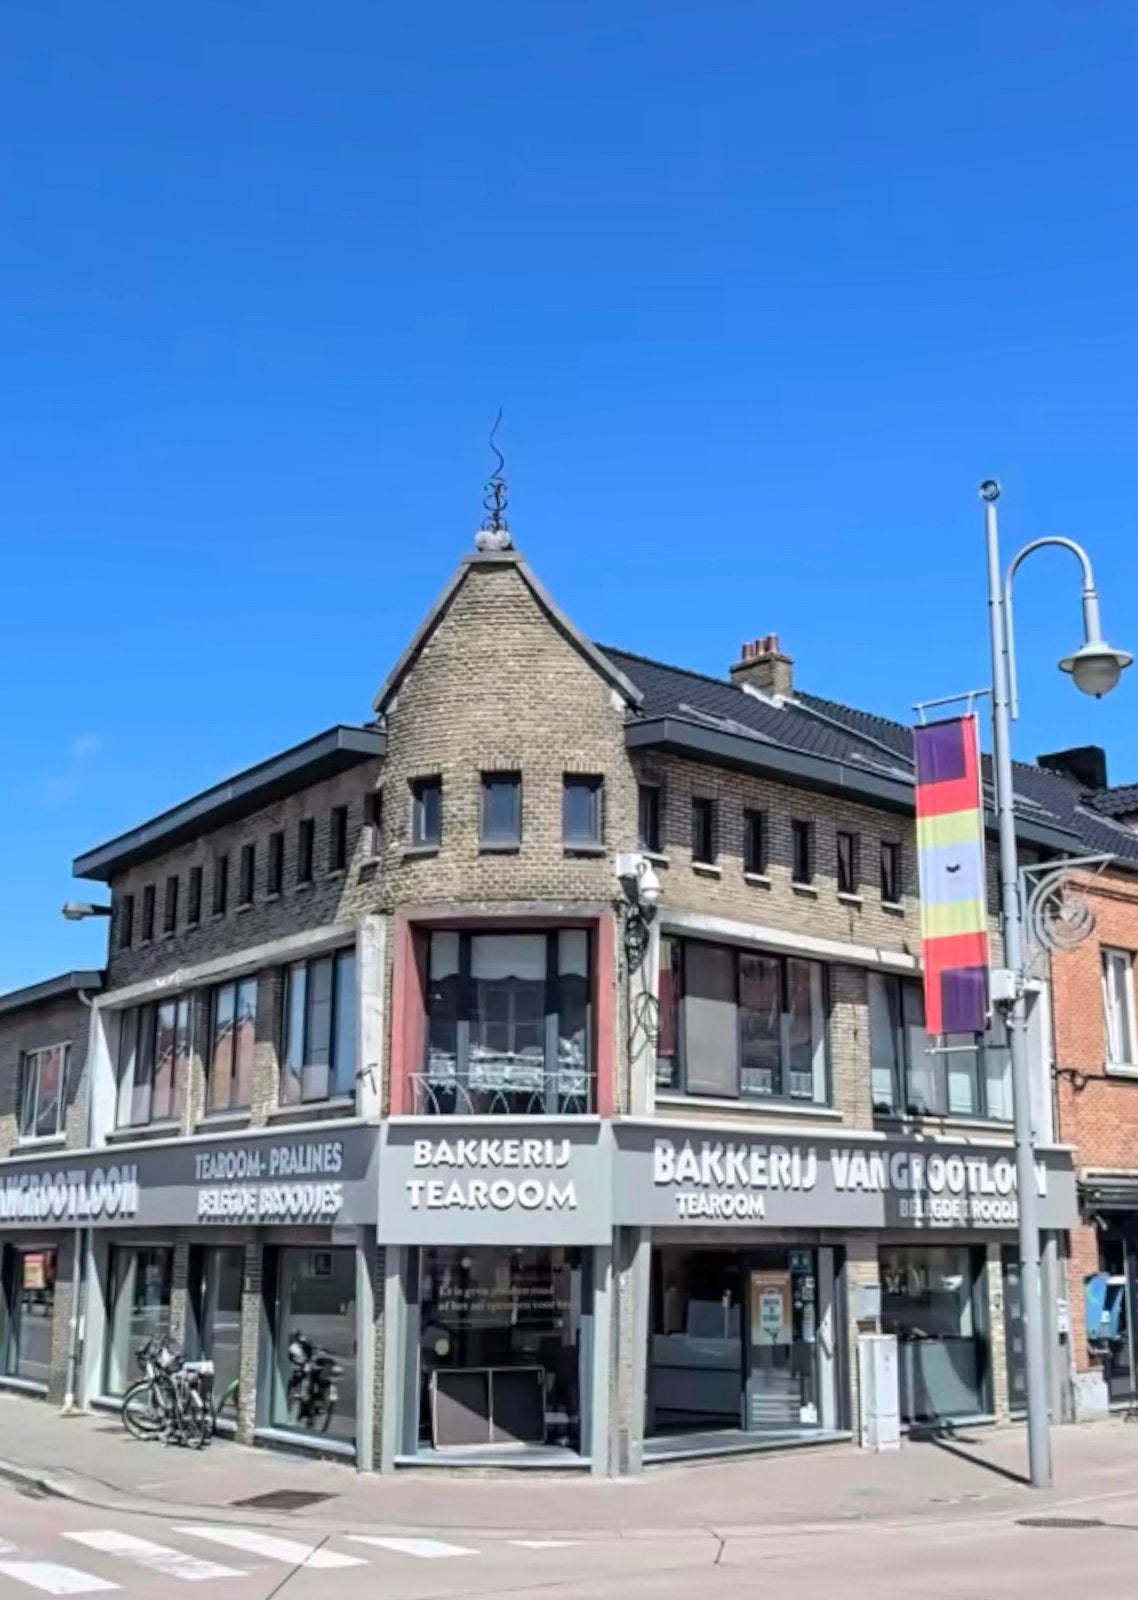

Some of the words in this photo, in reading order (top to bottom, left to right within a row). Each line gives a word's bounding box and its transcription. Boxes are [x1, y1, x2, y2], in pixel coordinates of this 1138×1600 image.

[269, 1142, 343, 1175] PRALINES
[414, 1139, 571, 1167] BAKKERIJ
[654, 1138, 818, 1189] BAKKERIJ
[830, 1149, 1047, 1196] VANGROOTLON
[197, 1187, 257, 1215] BELEGDE
[258, 1183, 343, 1215] BROODJES
[406, 1179, 577, 1209] TEAROOM
[676, 1192, 765, 1218] TEAROOM
